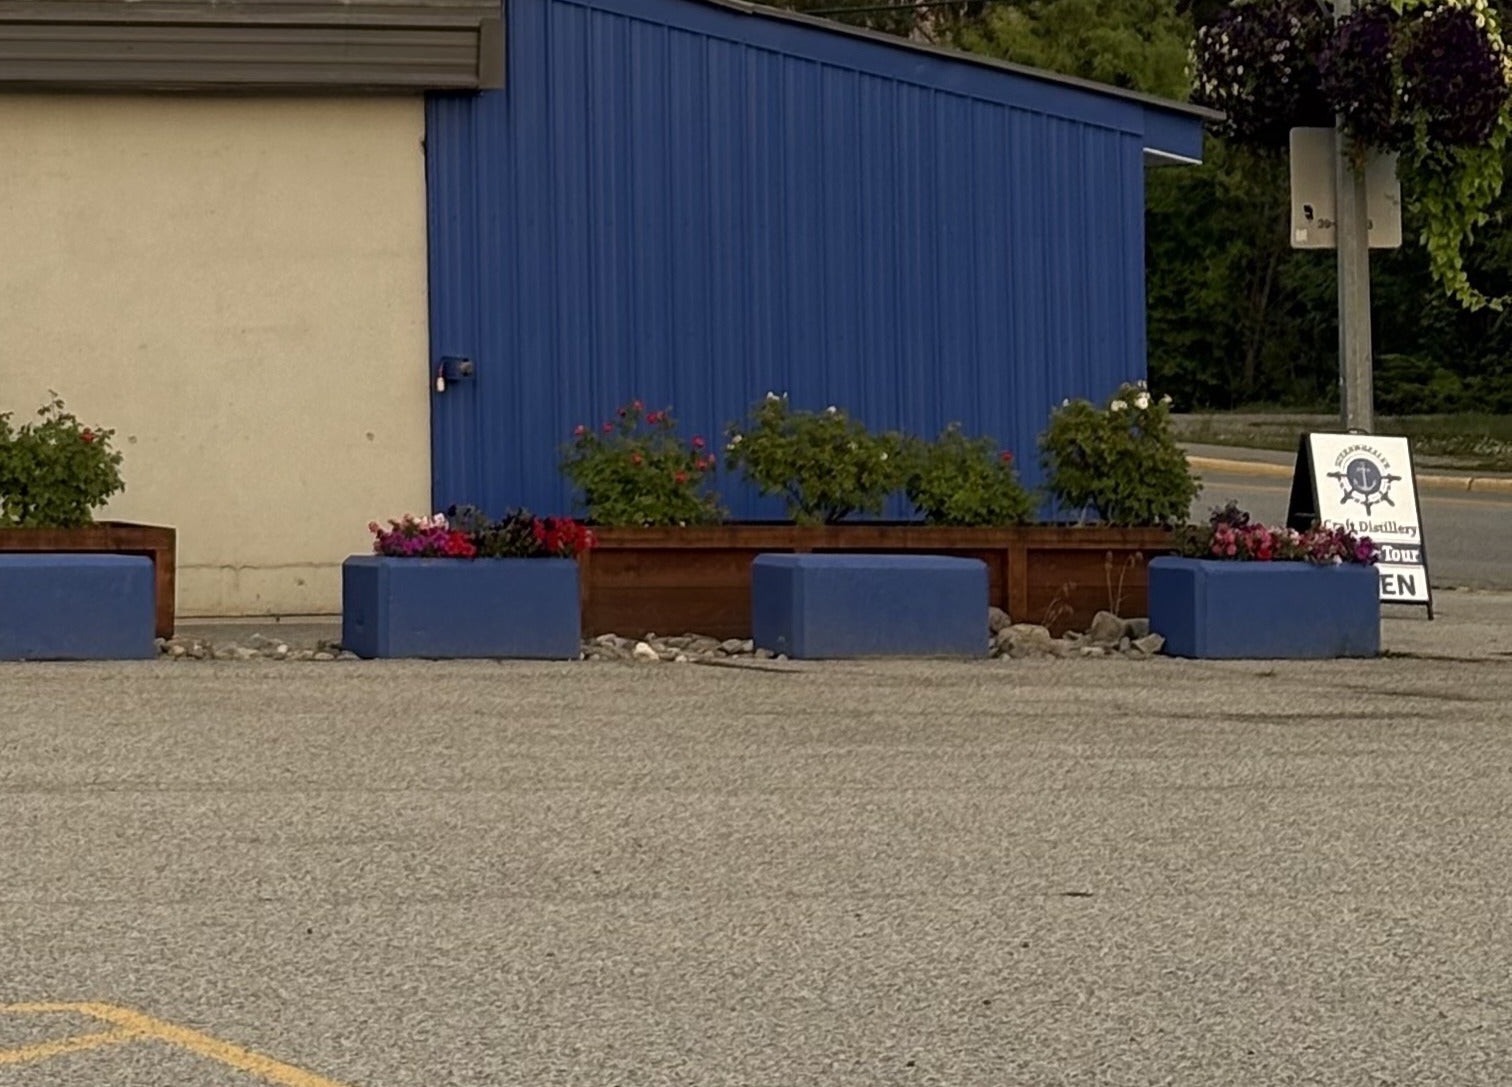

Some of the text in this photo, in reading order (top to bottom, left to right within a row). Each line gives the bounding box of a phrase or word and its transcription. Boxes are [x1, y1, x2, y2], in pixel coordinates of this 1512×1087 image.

[1359, 520, 1417, 538] Distillery
[1381, 545, 1420, 562] Tour
[1379, 574, 1416, 596] EN
